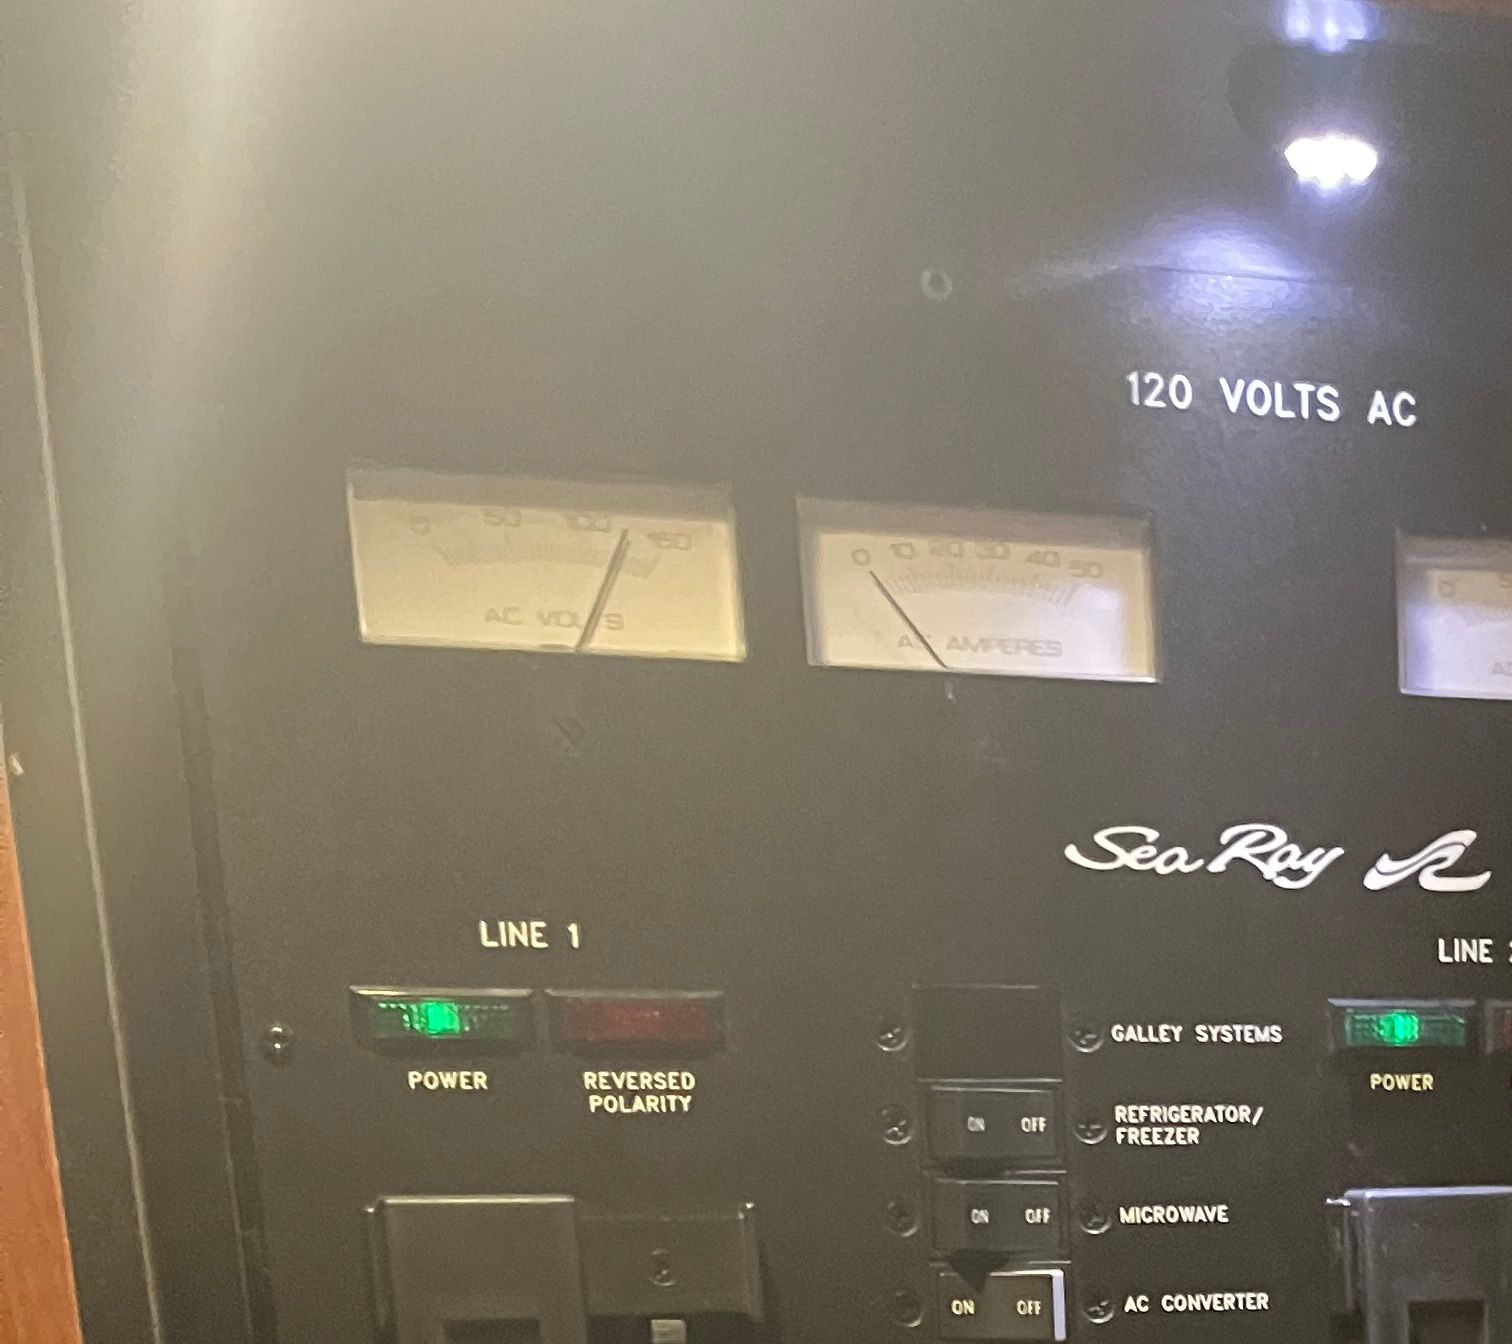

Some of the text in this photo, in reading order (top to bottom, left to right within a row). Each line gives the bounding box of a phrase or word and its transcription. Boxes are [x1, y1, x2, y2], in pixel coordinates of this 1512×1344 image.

[1126, 371, 1418, 427] 120 VOLTS AC
[1064, 822, 1345, 891] Sea Ray
[480, 921, 580, 948] LINE 1
[1439, 938, 1492, 962] LINE
[1111, 1024, 1282, 1043] GALLEY SYSTEMS
[409, 1071, 487, 1089] POWER
[584, 1072, 695, 1090] REVERSED
[1371, 1074, 1433, 1090] POWER
[589, 1095, 691, 1113] POLARITY
[1115, 1105, 1263, 1125] REFRIGERATOR/
[1021, 1117, 1046, 1132] OFF
[1117, 1127, 1199, 1145] FREEZER
[1120, 1205, 1228, 1223] MICROWAVE
[952, 1300, 1040, 1314] ON OFF
[1125, 1293, 1268, 1312] AC CONVERTER
